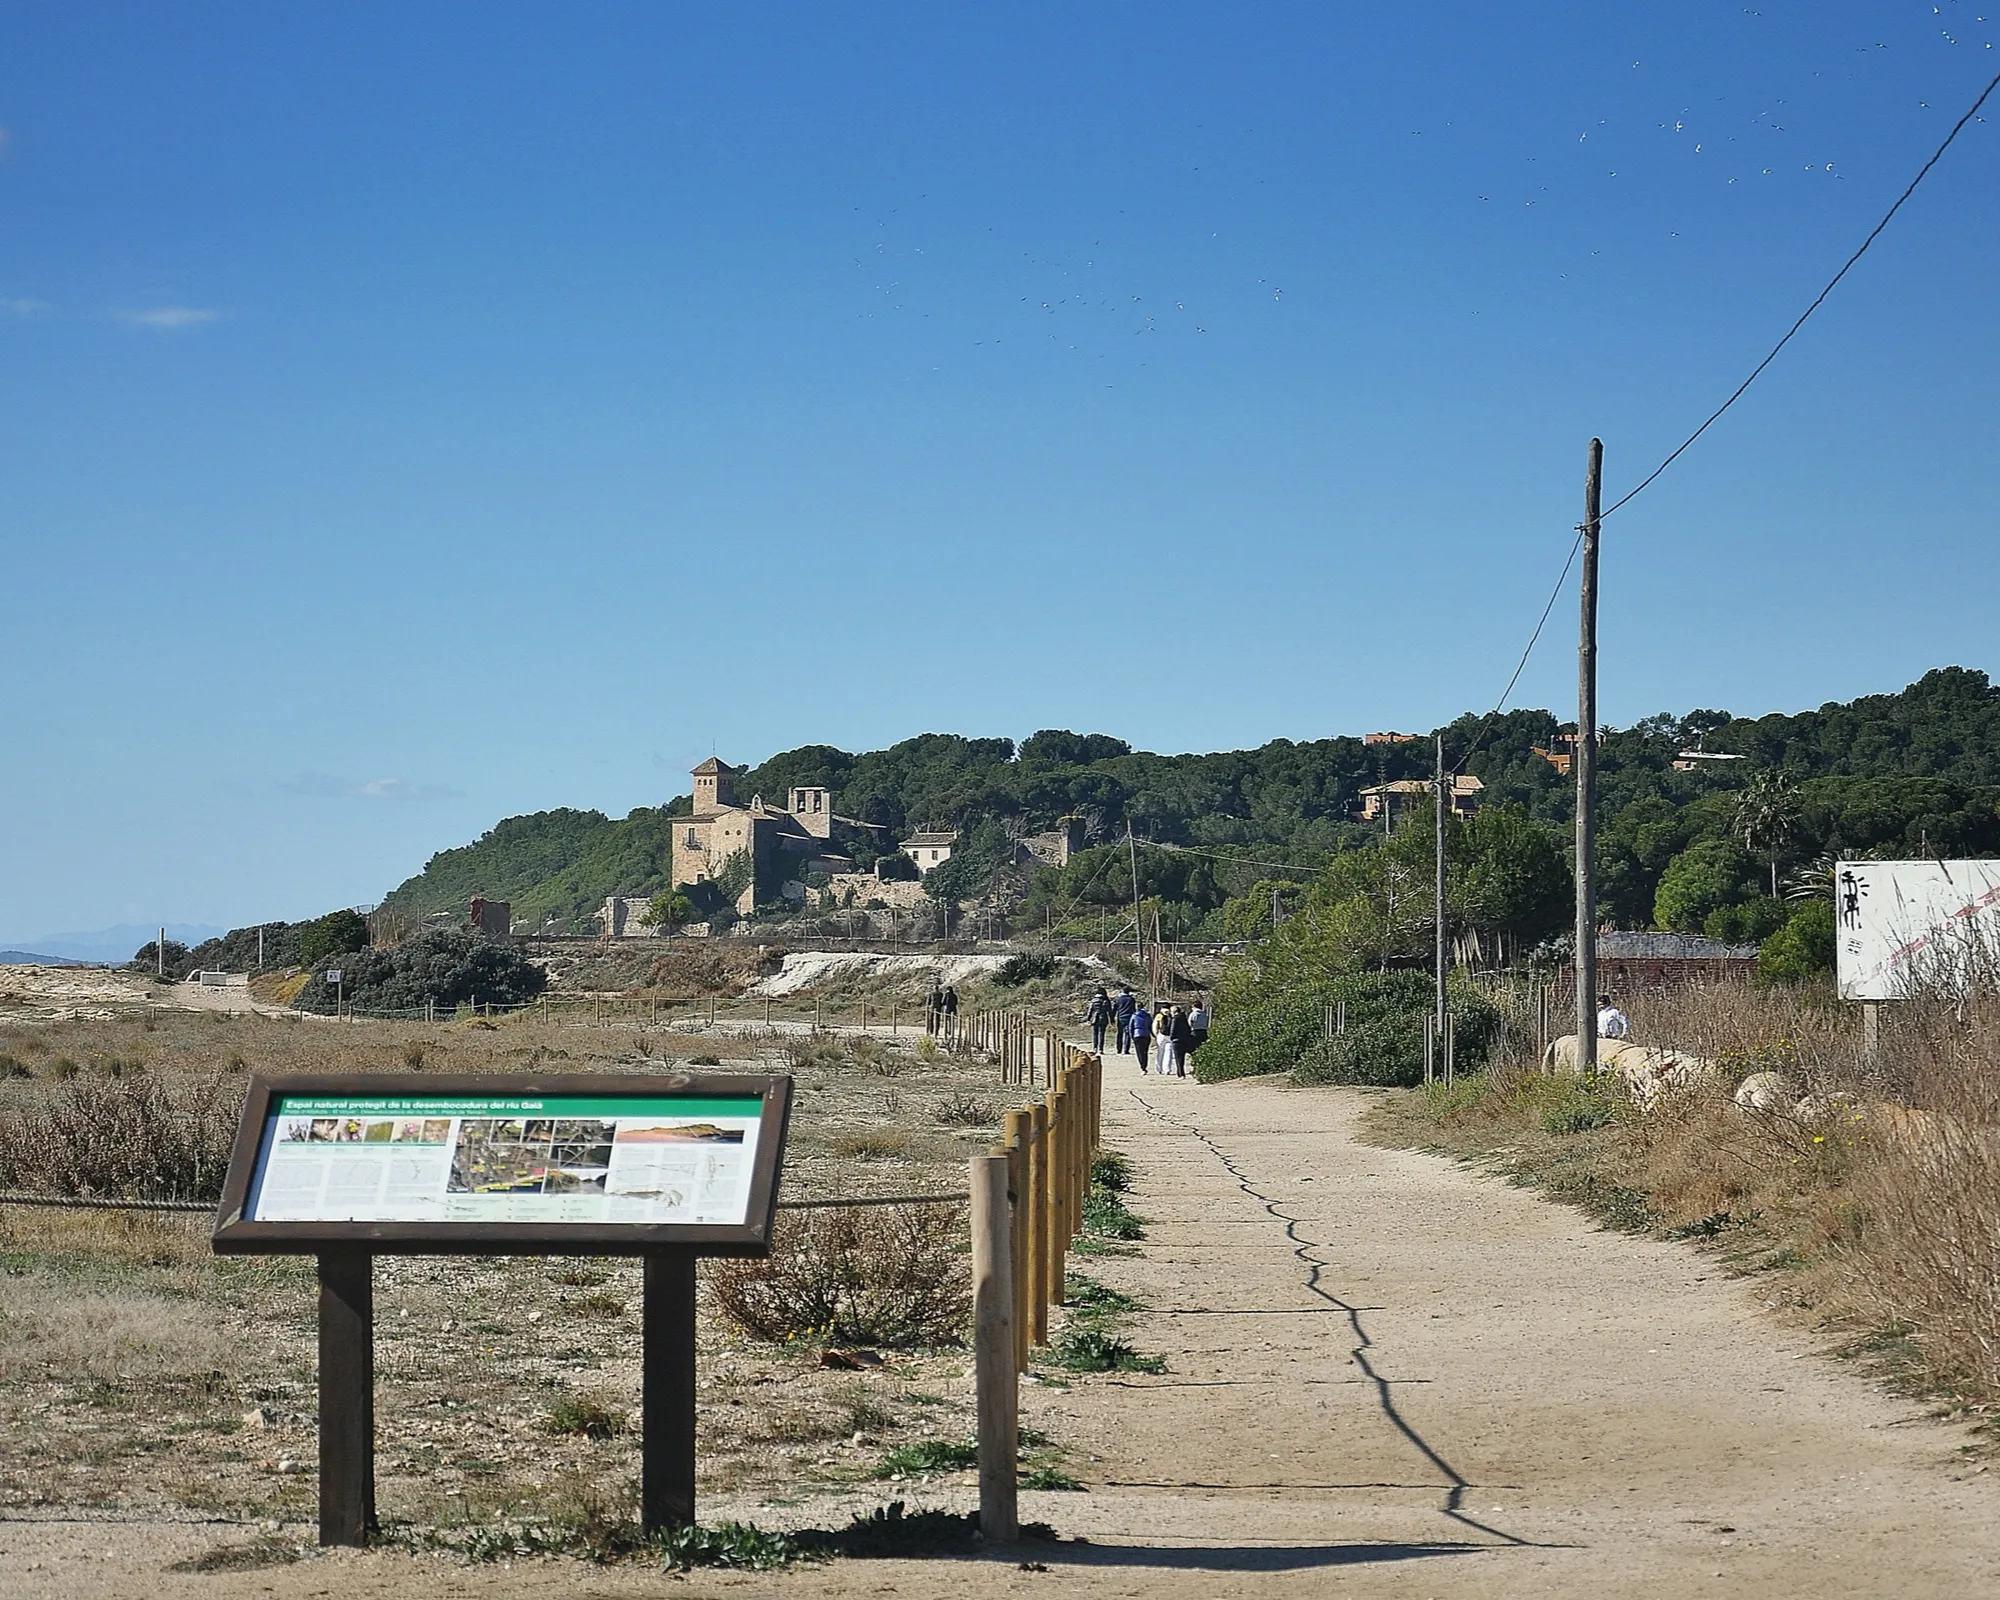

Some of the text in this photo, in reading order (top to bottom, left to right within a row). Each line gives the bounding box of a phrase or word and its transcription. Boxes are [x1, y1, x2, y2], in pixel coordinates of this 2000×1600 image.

[314, 1101, 347, 1109] natural
[348, 1101, 386, 1111] protegit
[388, 1101, 400, 1109] de
[402, 1101, 411, 1109] la
[412, 1101, 488, 1110] desembocadura
[489, 1101, 504, 1109] del
[506, 1101, 519, 1109] riu
